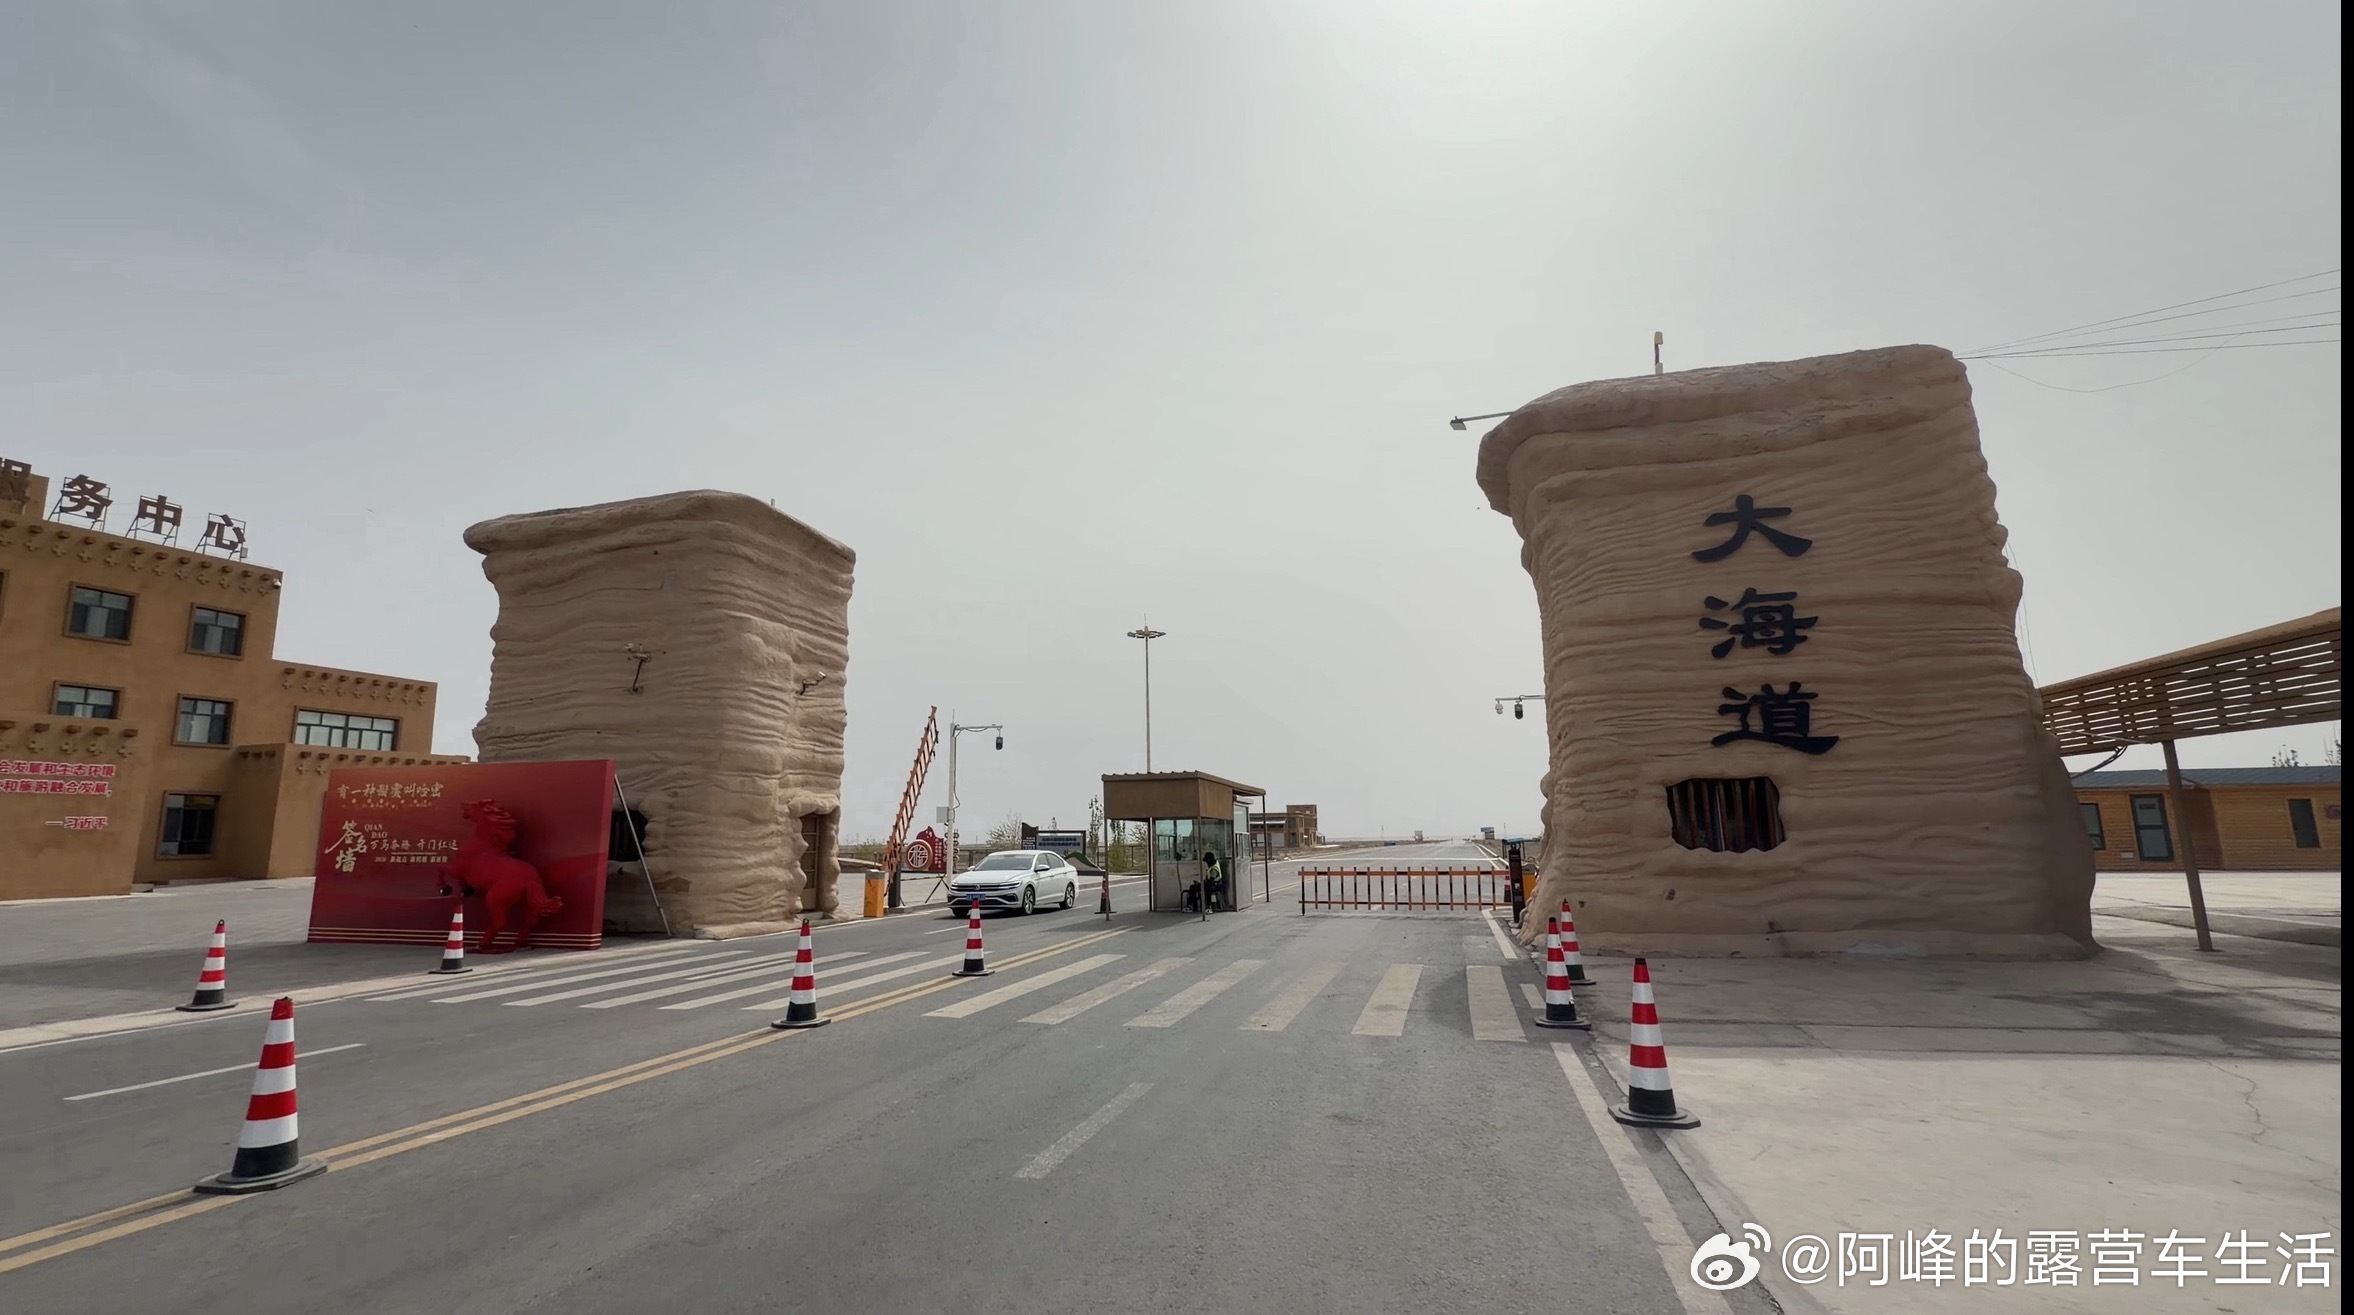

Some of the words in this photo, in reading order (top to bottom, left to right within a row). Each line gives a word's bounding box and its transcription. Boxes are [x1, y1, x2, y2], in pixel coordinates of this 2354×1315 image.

[1691, 494, 1839, 755] 大海道
[364, 823, 383, 832] QIAN
